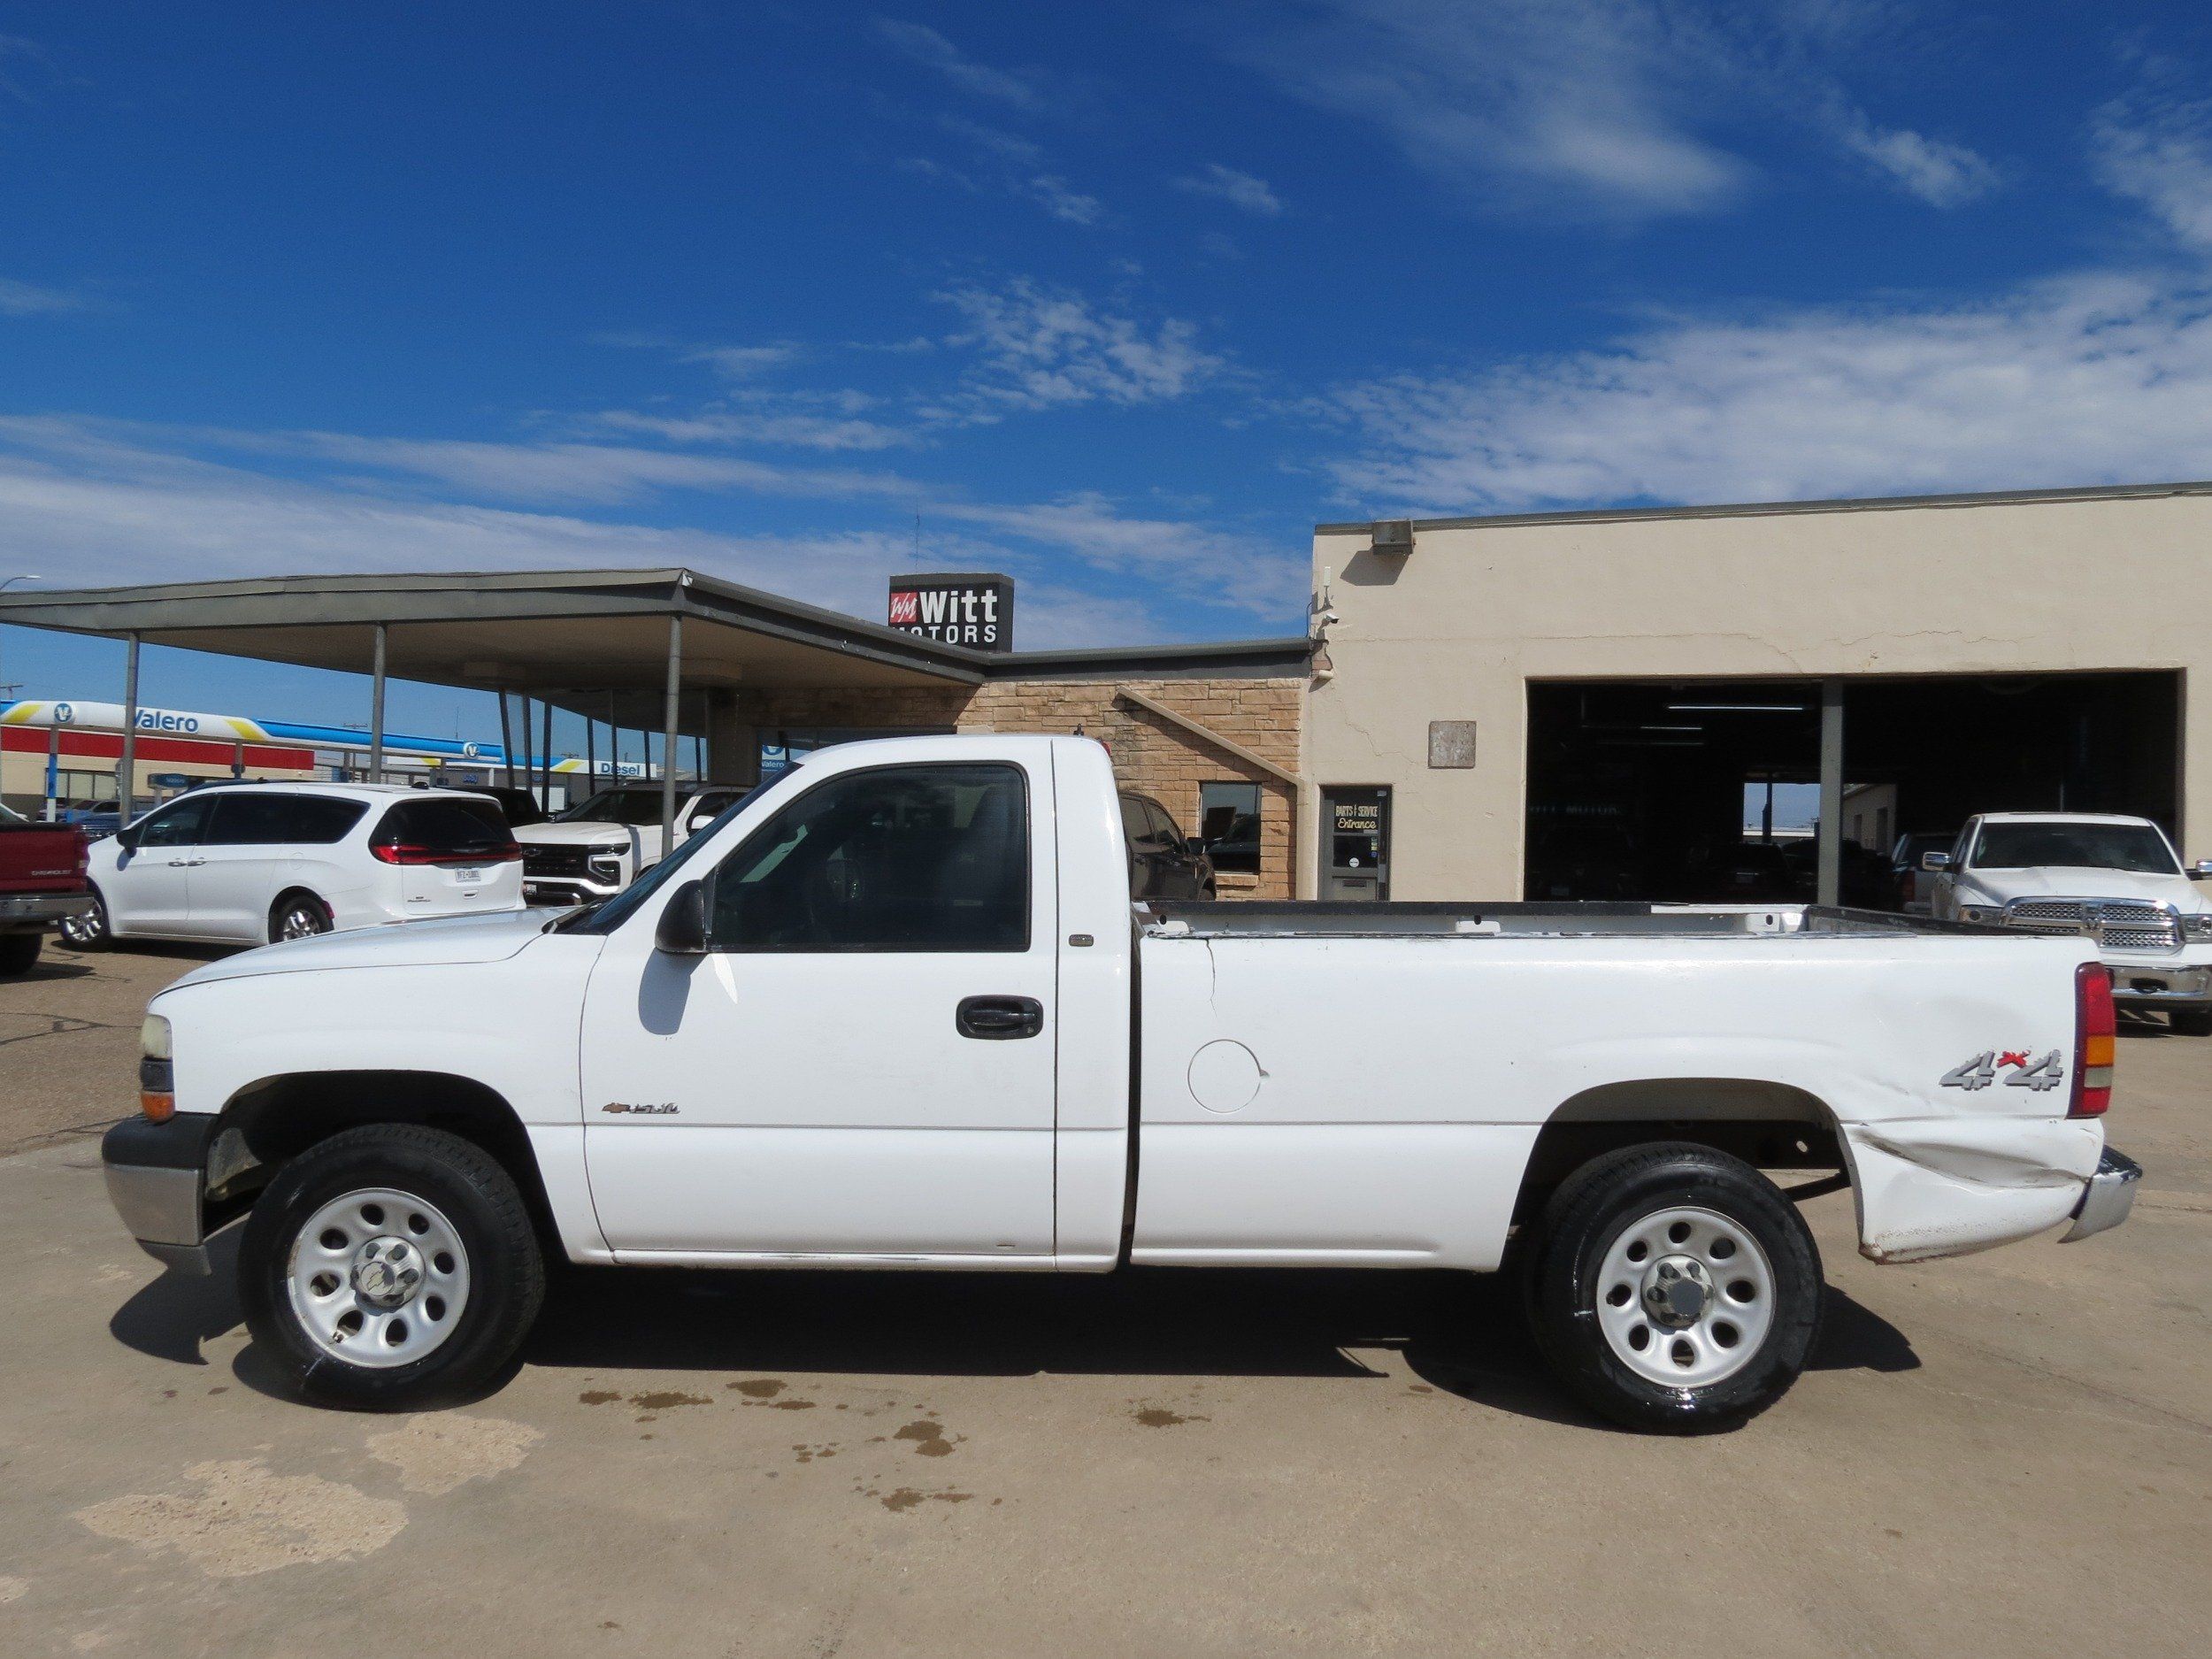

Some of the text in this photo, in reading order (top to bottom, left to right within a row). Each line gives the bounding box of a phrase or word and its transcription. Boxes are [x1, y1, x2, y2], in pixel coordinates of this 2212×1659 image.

[919, 589, 998, 624] Witt
[893, 625, 997, 644] OTORS
[1335, 805, 1354, 817] PARTS
[1357, 805, 1379, 817] SERVICE
[1337, 817, 1377, 829] Entrance
